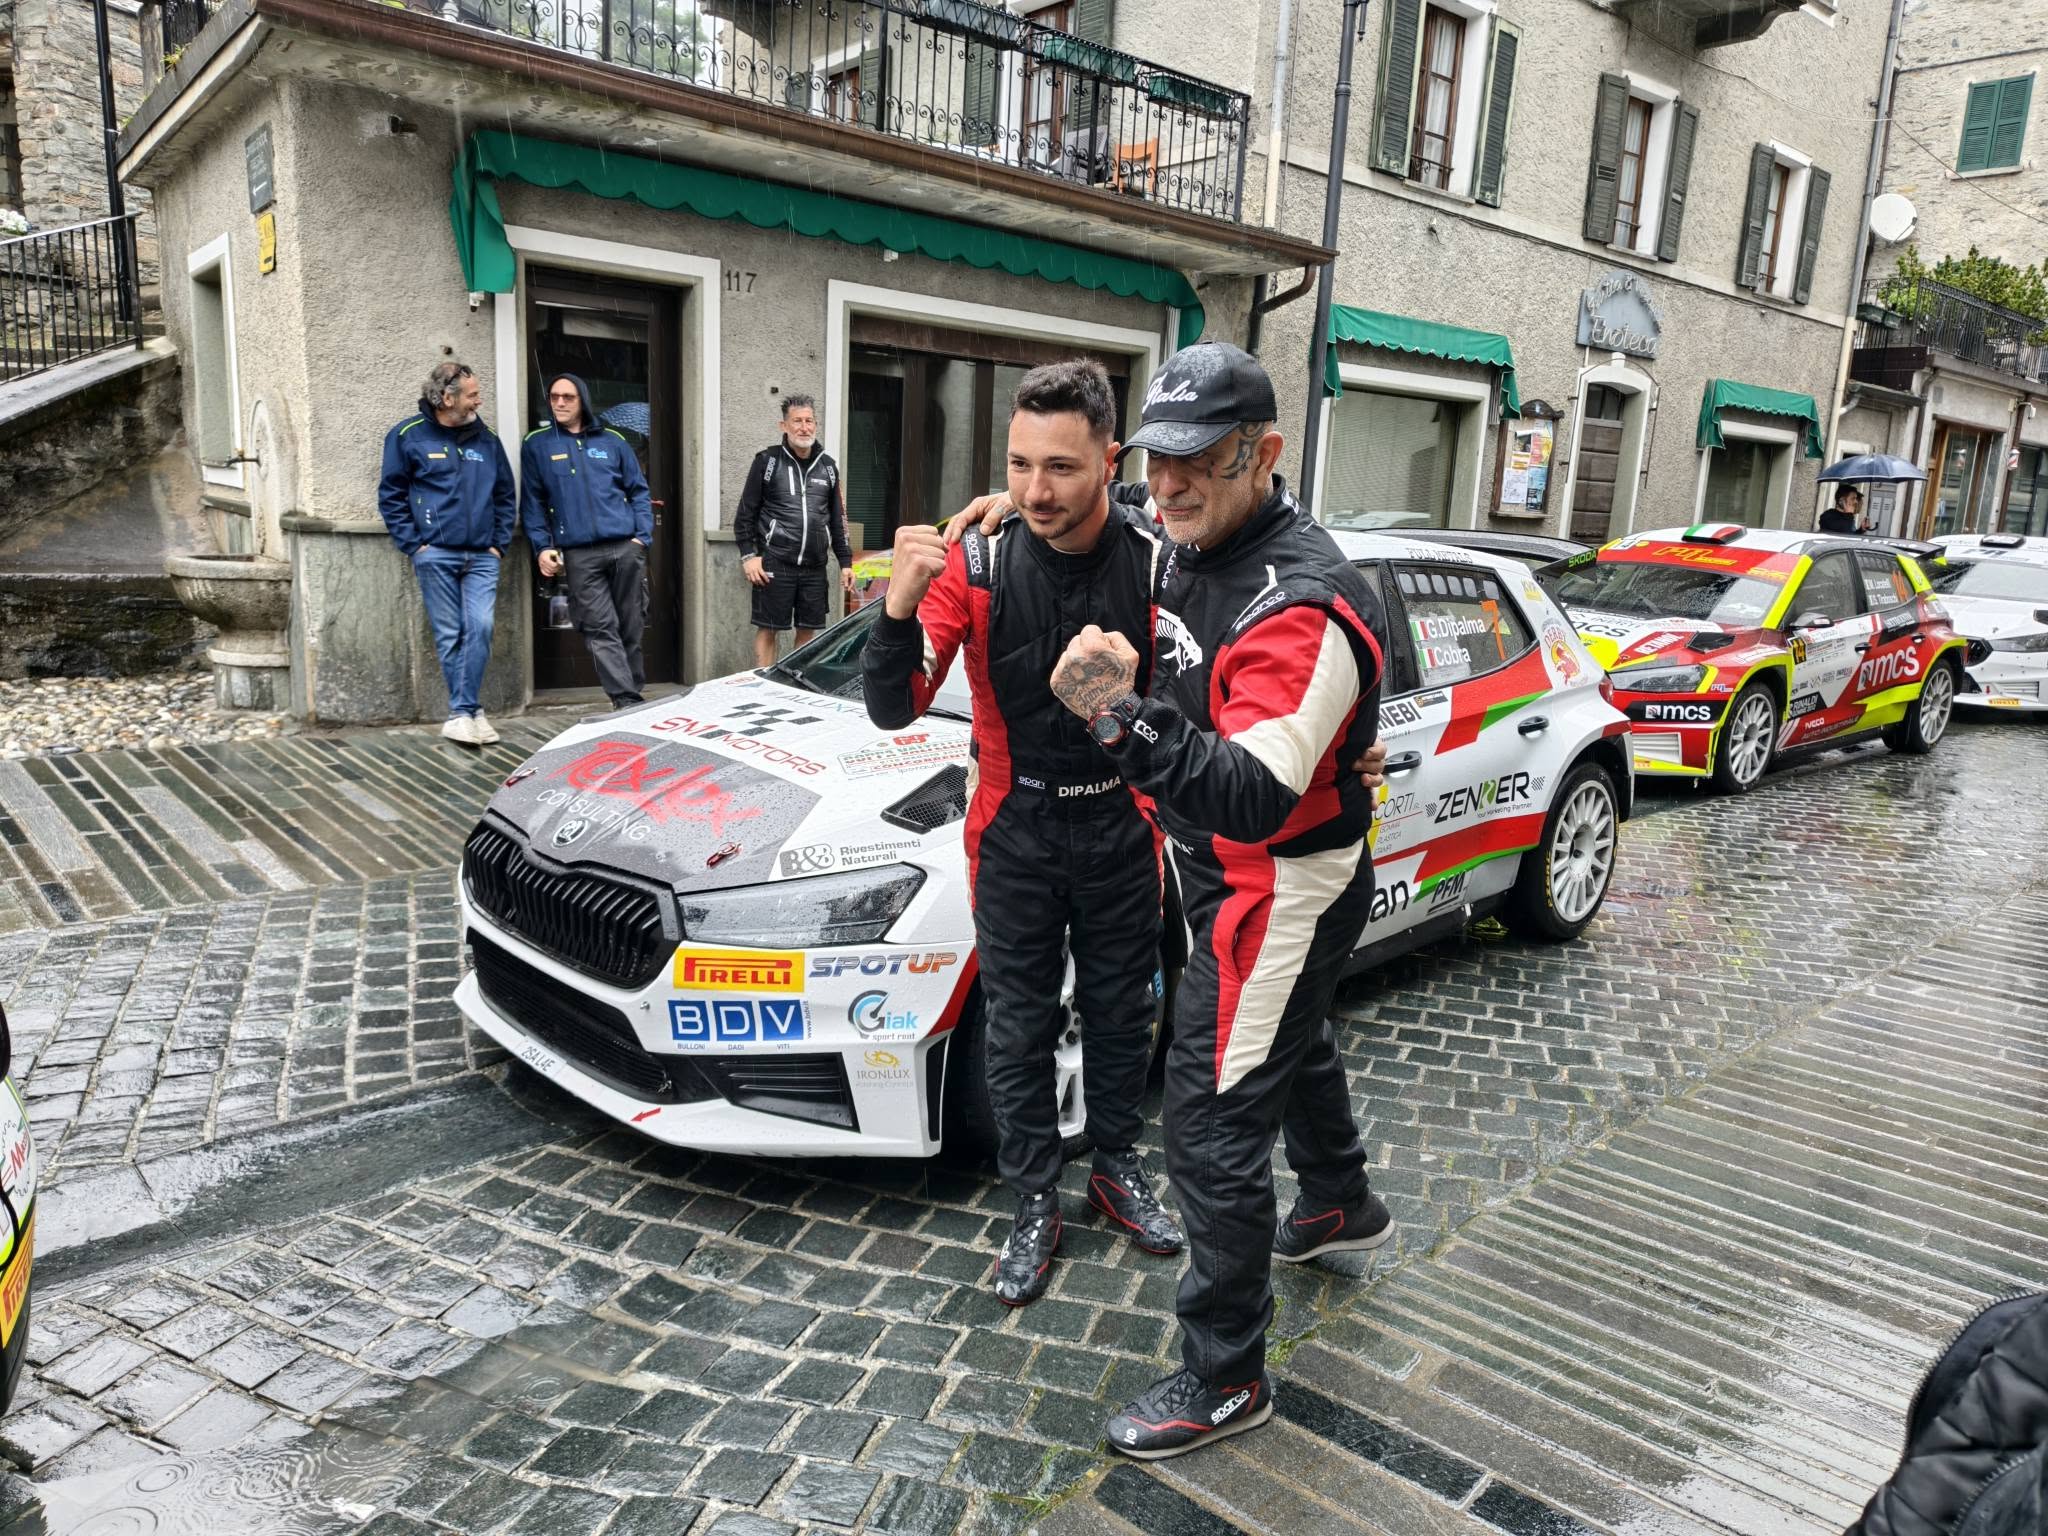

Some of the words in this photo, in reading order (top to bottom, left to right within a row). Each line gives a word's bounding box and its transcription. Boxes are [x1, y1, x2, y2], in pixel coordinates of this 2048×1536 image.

[725, 269, 757, 292] 117
[1591, 316, 1657, 354] Enoteca
[1142, 371, 1199, 414] Italia
[965, 533, 982, 575] sparco
[1427, 616, 1486, 640] G.Dipalma
[1480, 600, 1506, 661] 7
[1434, 647, 1471, 667] Cobra
[1872, 646, 1919, 686] mcs
[1662, 705, 1711, 720] mcs
[721, 734, 827, 776] MOTORS
[1058, 776, 1121, 797] DIPALMA
[536, 789, 651, 841] CONSULTING
[1375, 792, 1415, 820] CORTI
[781, 844, 835, 877] B&B
[840, 839, 921, 856] Rivestimenti
[842, 851, 897, 866] Naturali
[684, 957, 792, 985] PIRELLI
[809, 952, 958, 978] SPOTUP
[873, 1033, 895, 1041] sport
[857, 1069, 910, 1080] IRONLUX
[1211, 1389, 1250, 1425] sparco
